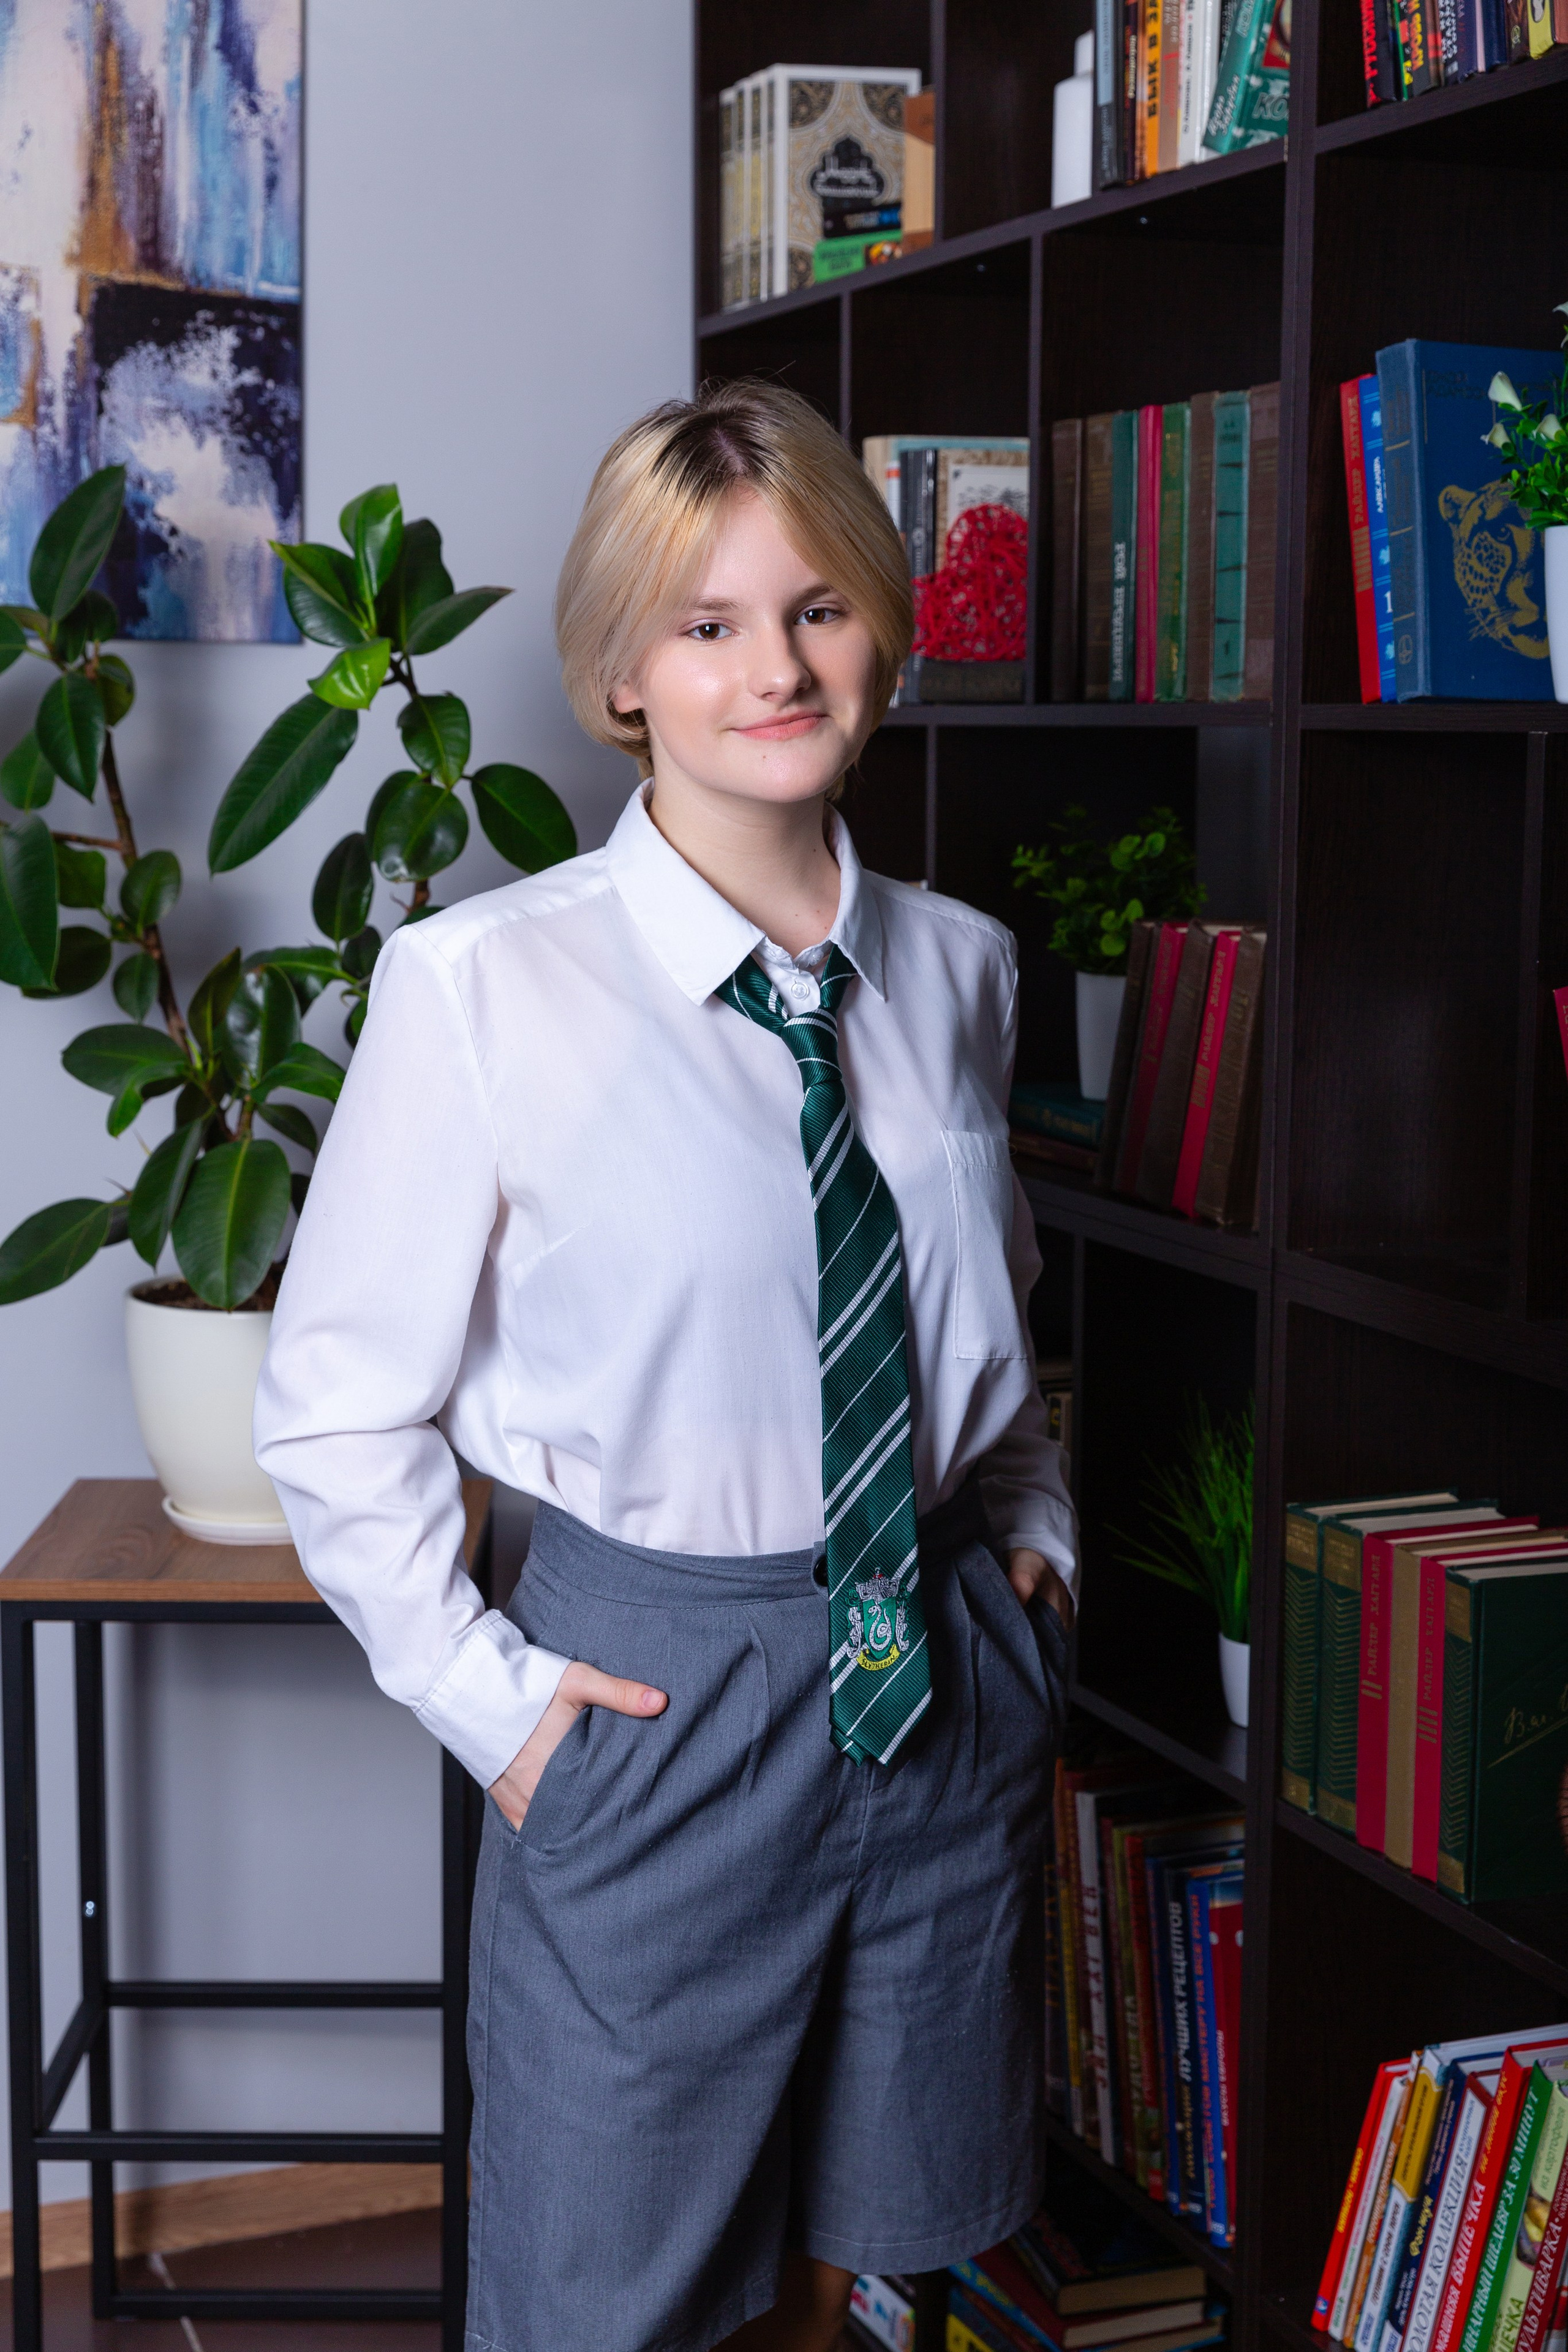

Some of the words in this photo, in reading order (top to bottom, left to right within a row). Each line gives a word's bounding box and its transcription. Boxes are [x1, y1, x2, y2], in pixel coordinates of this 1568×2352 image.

[1251, 92, 1289, 120] КО
[861, 1654, 896, 1670] SLYTHERIN
[1189, 1894, 1200, 1938] РУКИ
[1167, 1901, 1188, 1997] РЕЦЕПТОВ
[1193, 1943, 1203, 1976] ВСЕ
[1195, 1980, 1204, 2002] НА
[1173, 1998, 1192, 2081] ЛУЧШИХ
[1196, 2005, 1210, 2082] МАСТЕРУ
[1513, 2086, 1540, 2160] МИНУТ
[1449, 2178, 1485, 2286] ВЫПЕЧКА
[1478, 2155, 1490, 2174] на
[1494, 2070, 1510, 2106] вкус
[1501, 2180, 1516, 2205] ЗА
[1507, 2158, 1522, 2180] 30
[1427, 2152, 1469, 2275] КОЛЛЕКЦИЯ
[1483, 2201, 1512, 2272] ШЕДЕВР
